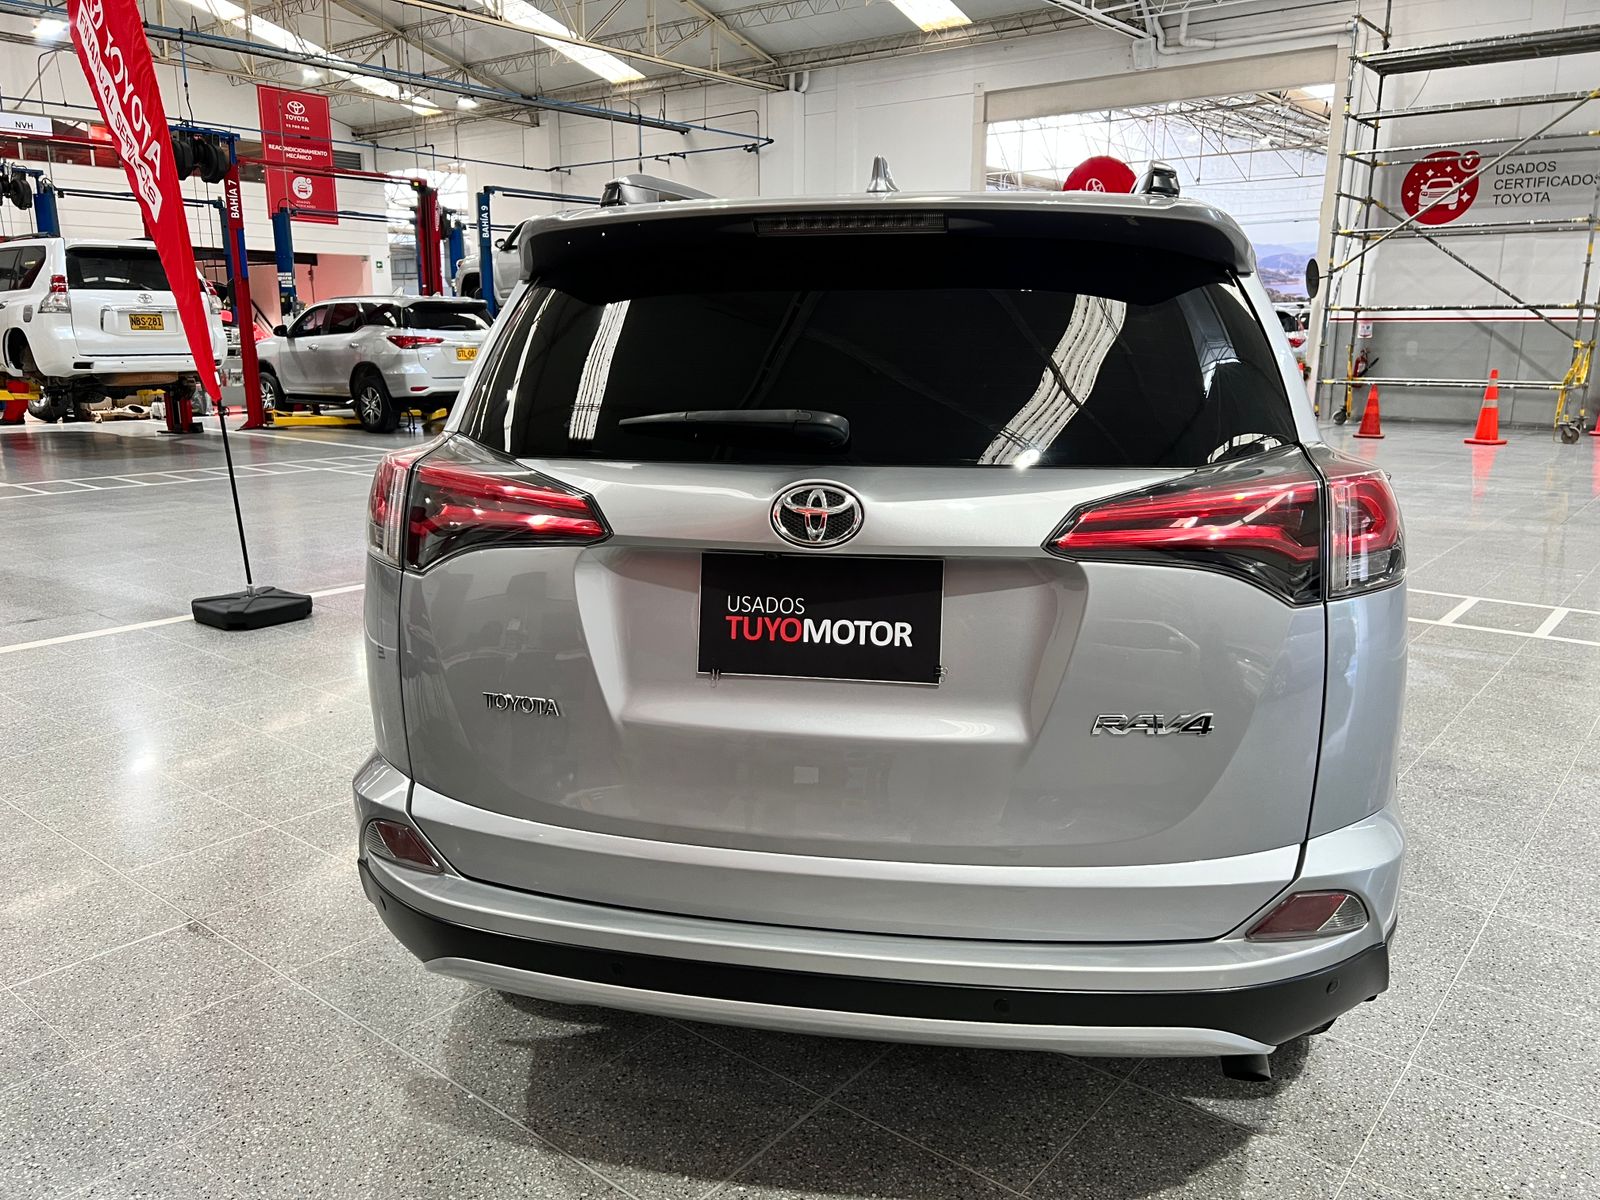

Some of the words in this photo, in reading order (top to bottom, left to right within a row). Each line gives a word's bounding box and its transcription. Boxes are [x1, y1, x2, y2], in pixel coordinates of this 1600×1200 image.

[79, 11, 114, 116] FINANCAL
[104, 24, 161, 180] TOYOTA
[15, 121, 34, 130] NVH
[285, 114, 309, 123] TOYOTA
[285, 152, 312, 161] MECÁNICO
[1495, 161, 1557, 175] USADOS
[227, 188, 240, 219] BAHÍA
[1493, 192, 1550, 205] TOYOTA
[480, 213, 490, 238] BAHÍA
[727, 595, 805, 615] USADOS
[725, 615, 913, 647] TUYOMOTOR
[482, 691, 560, 717] TOYOTA
[1090, 711, 1215, 736] RAV4
